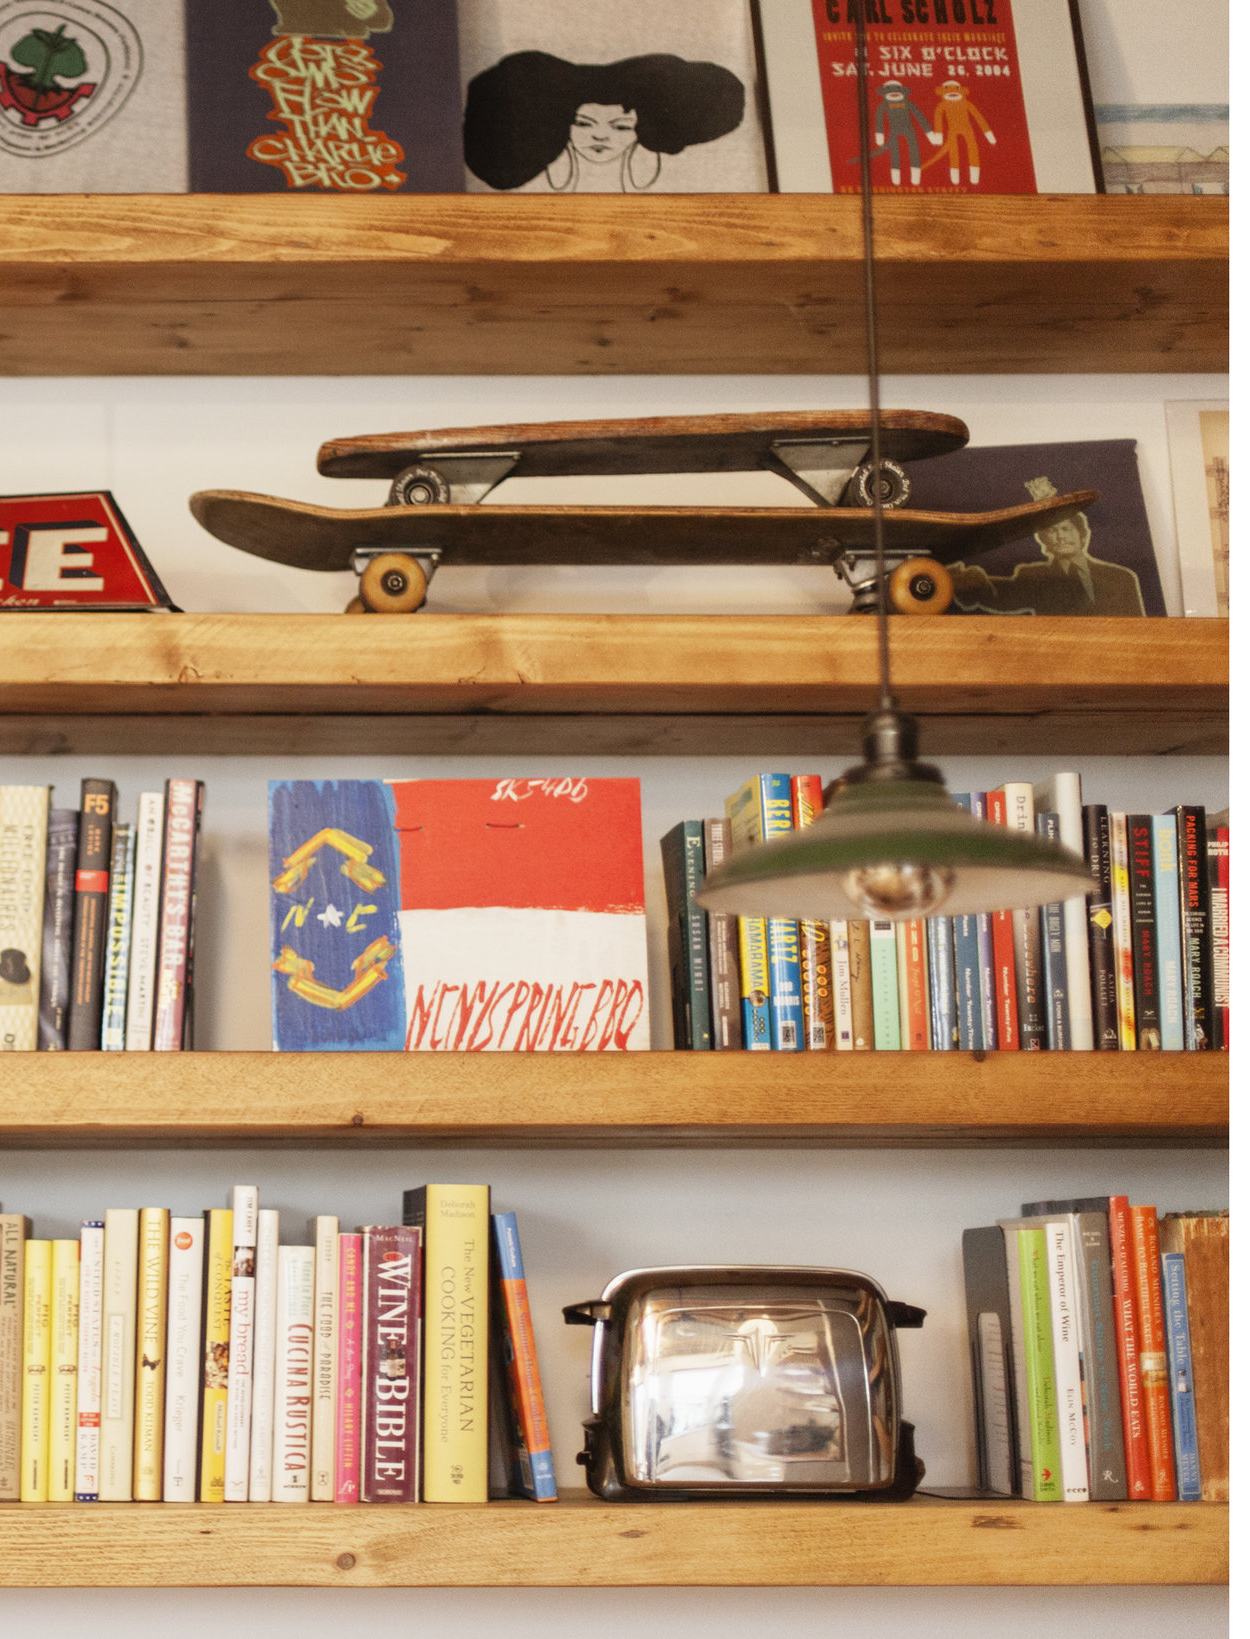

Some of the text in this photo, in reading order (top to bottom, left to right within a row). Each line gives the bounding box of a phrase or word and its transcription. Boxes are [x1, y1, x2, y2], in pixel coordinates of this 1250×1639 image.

[902, 0, 998, 25] SCHOLZ
[832, 62, 1010, 77] SA. JUNE 26, 2004
[880, 46, 912, 60] SIX
[922, 47, 1008, 60] O'CLOCK
[84, 794, 109, 815] F5
[1101, 816, 1110, 884] LEARNING
[163, 924, 184, 965] BAR
[281, 897, 315, 932] N
[687, 836, 703, 992] EVENING SUSAN MINOT
[1134, 827, 1152, 996] STIFF MARY ROACH
[1158, 829, 1178, 1023] bonk MARY ROACH
[1187, 815, 1201, 999] PACKING FOR MARS MARY ROACH
[1213, 893, 1228, 936] MARRIED
[108, 885, 128, 1016] IMPOSSIBLE
[838, 962, 849, 1017] Jim Mullen
[1023, 924, 1037, 1004] Elsewhere
[1214, 947, 1229, 1008] COMMUNIST
[6, 1222, 18, 1246] ALL
[147, 1219, 161, 1249] THE
[1118, 1211, 1126, 1242] MENZEL
[146, 1256, 160, 1299] WILD
[1055, 1231, 1070, 1341] The Emperor of Wine
[1171, 1264, 1186, 1363] Setting the Table
[145, 1306, 159, 1343] VINE
[174, 1273, 189, 1432] The Food You Crave Krieger
[236, 1290, 251, 1375] my bread
[320, 1292, 332, 1400] THE FOOD PARADISE
[343, 1247, 355, 1468] CANDY AND ME HILARY LIFTIN
[439, 1266, 455, 1442] COOKING for Everyone
[460, 1238, 474, 1432] The New VEGETARIAN
[146, 1381, 154, 1410] TODD
[285, 1323, 312, 1471] CUCINA RUSTICA
[375, 1253, 412, 1480] WINE BIBLE
[1123, 1299, 1141, 1438] WHAT THE WORLD EATS
